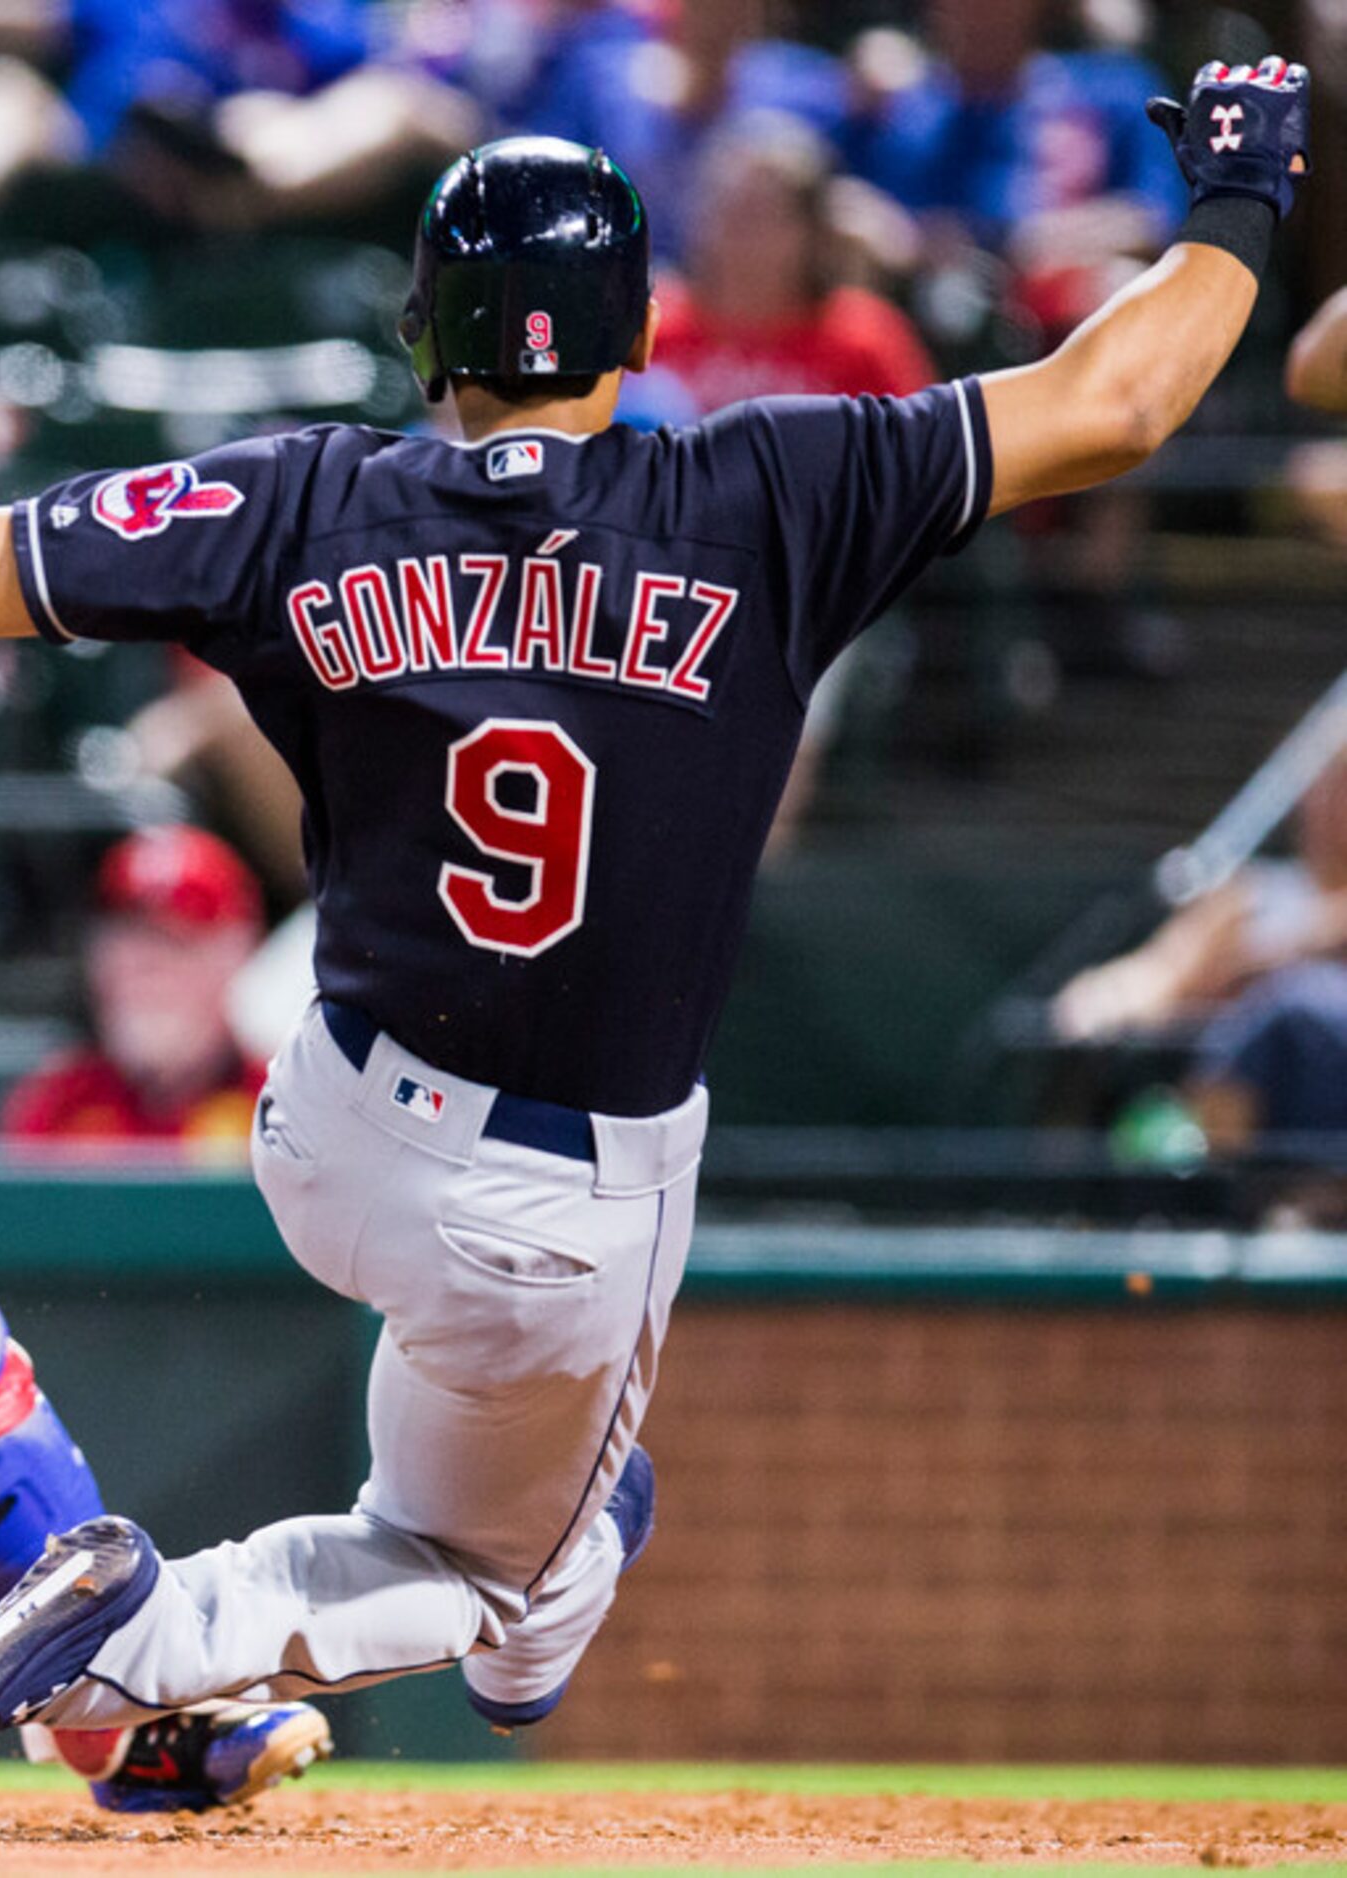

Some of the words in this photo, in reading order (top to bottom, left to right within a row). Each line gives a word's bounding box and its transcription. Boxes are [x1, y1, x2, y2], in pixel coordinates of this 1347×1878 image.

[526, 310, 552, 351] 9
[287, 529, 739, 701] GONZÁLEZ
[437, 717, 597, 959] 9
